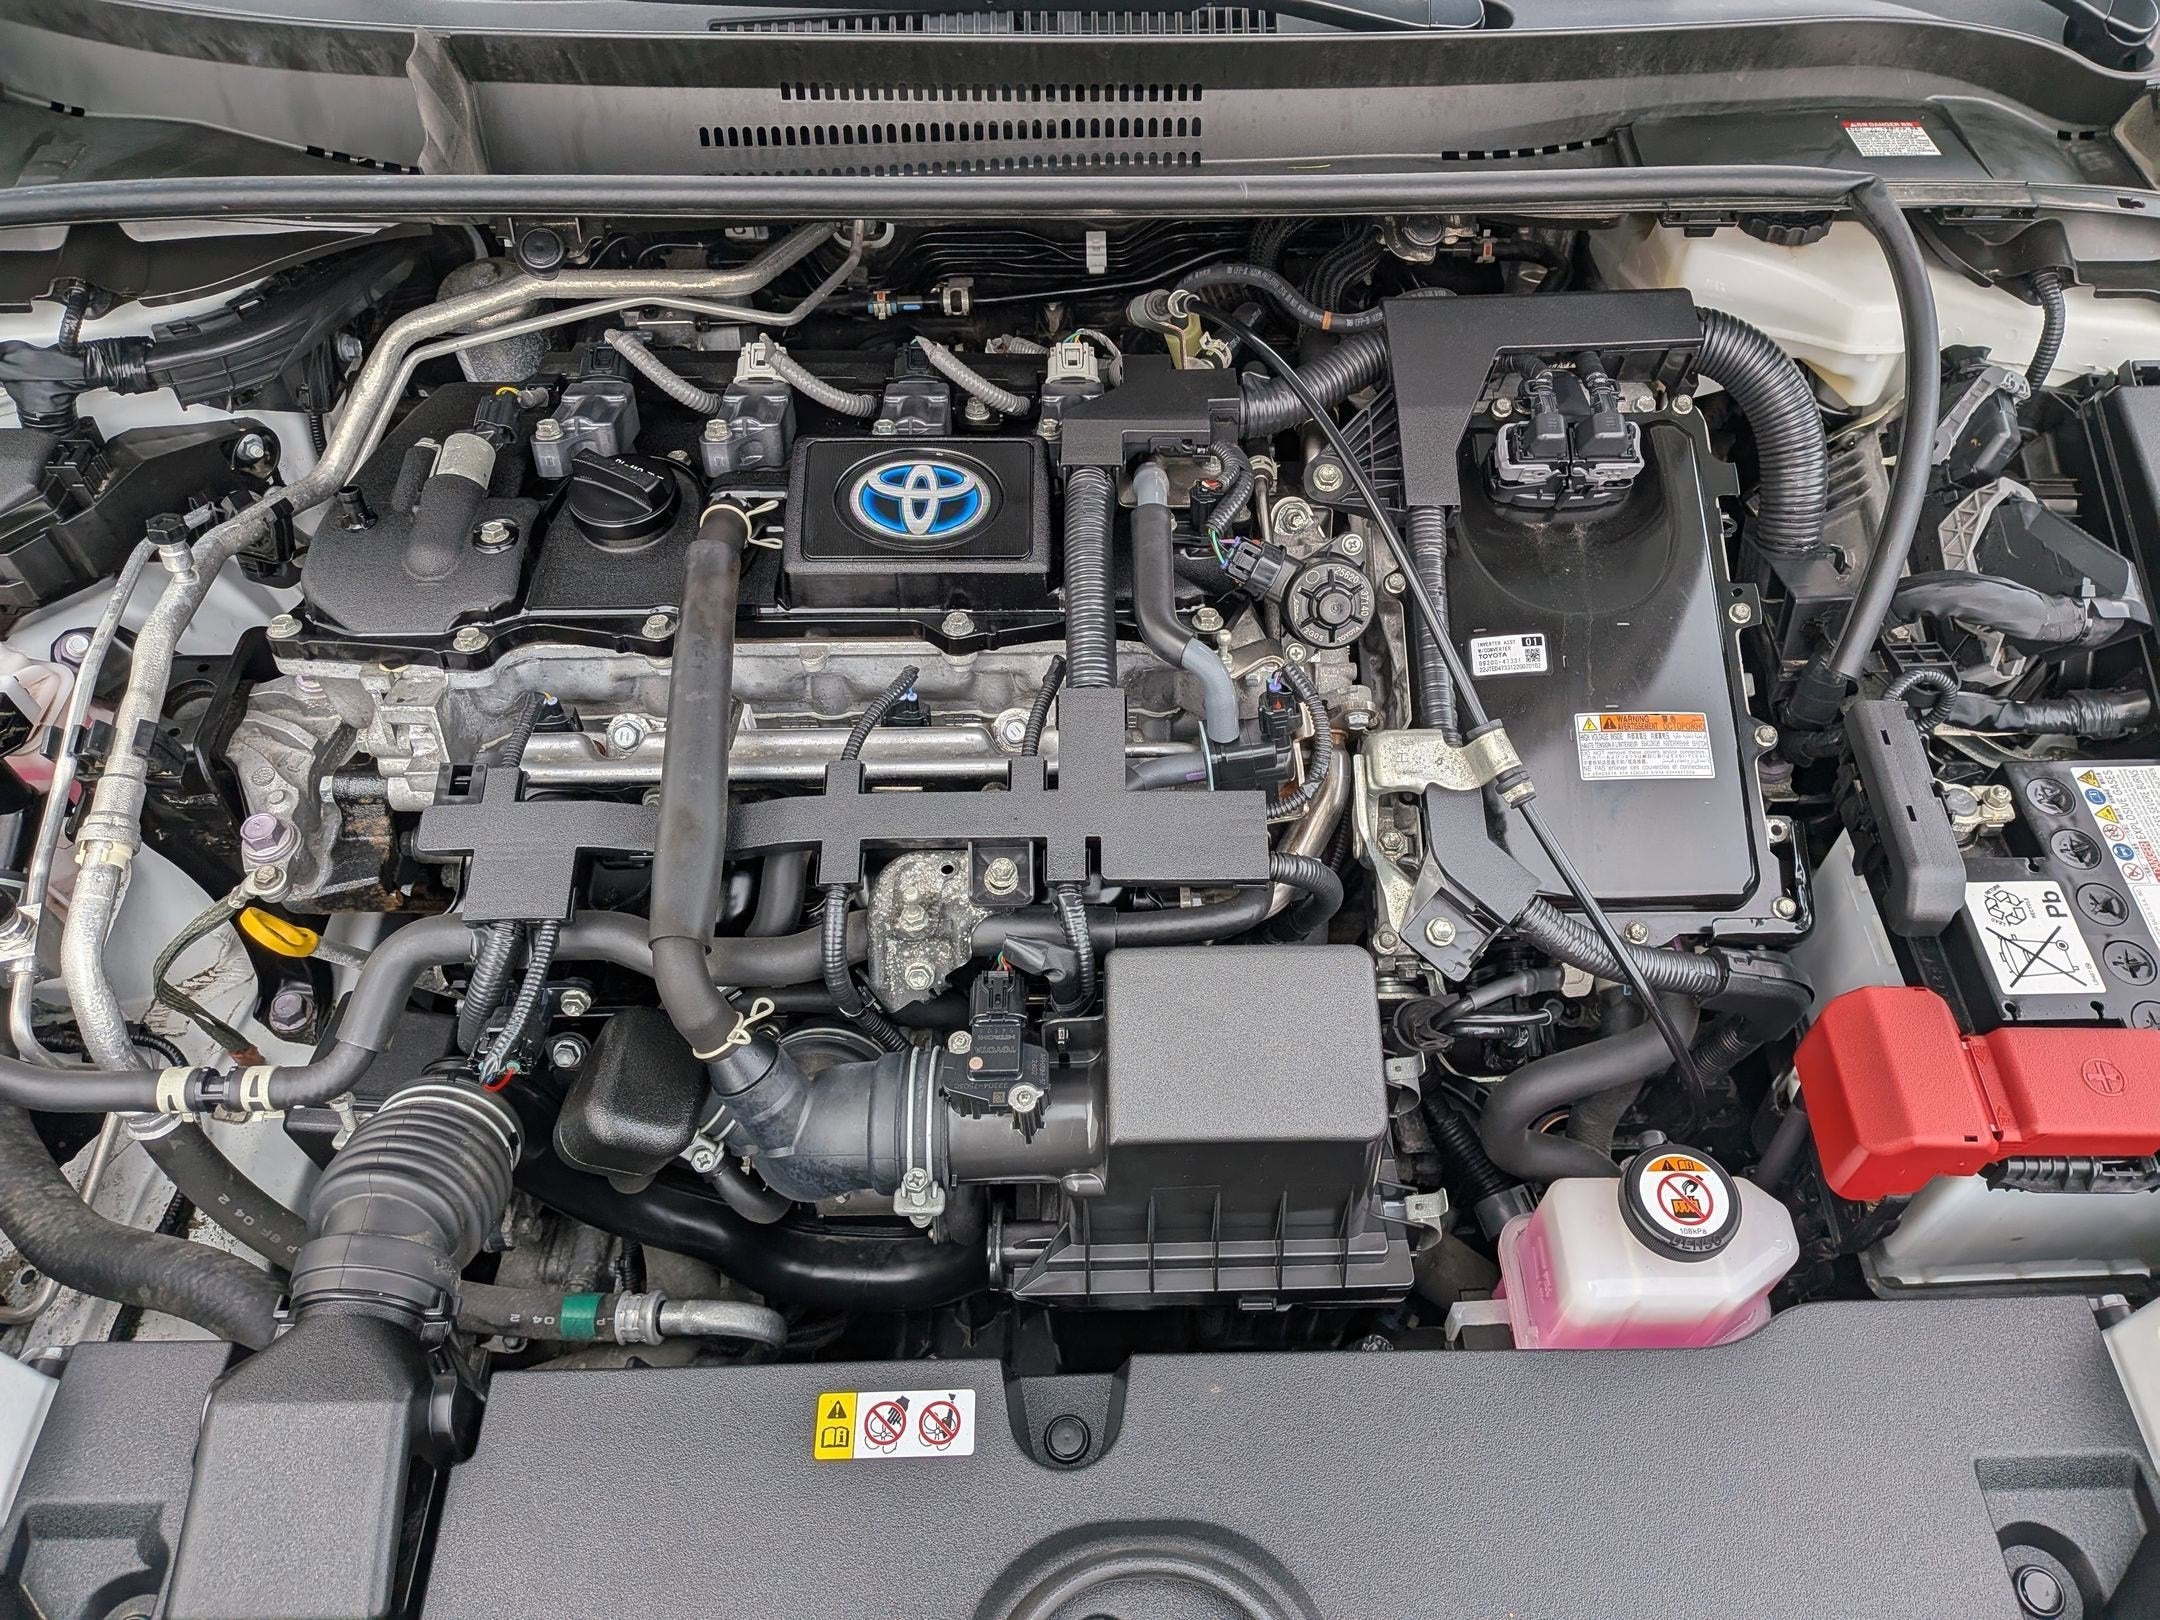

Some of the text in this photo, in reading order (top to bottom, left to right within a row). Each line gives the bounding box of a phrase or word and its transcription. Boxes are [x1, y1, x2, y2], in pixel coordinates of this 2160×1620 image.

[1334, 566, 1370, 617] 25620 37140
[1303, 627, 1325, 642] 2G05
[1337, 625, 1361, 643] TOYOTA
[1477, 640, 1501, 648] INVERTER
[1525, 637, 1537, 646] 01
[1478, 652, 1508, 660] TOYOTA
[1617, 715, 1649, 723] WARNING
[1617, 722, 1658, 730] AVERTISSEMENT
[2102, 769, 2123, 796] GASES
[2128, 769, 2147, 791] BURNS
[2139, 791, 2160, 815] SEVERE
[2115, 797, 2147, 840] EXPLOSIVE
[2023, 897, 2037, 919] RECYCLE
[2041, 890, 2069, 918] Pb
[974, 1044, 1017, 1054] TOYOTA
[217, 1193, 231, 1205] 2
[1679, 1227, 1708, 1235] 108kPa
[1669, 1235, 1722, 1251] DENSO
[509, 1313, 521, 1323] 2
[531, 1314, 556, 1325] 04
